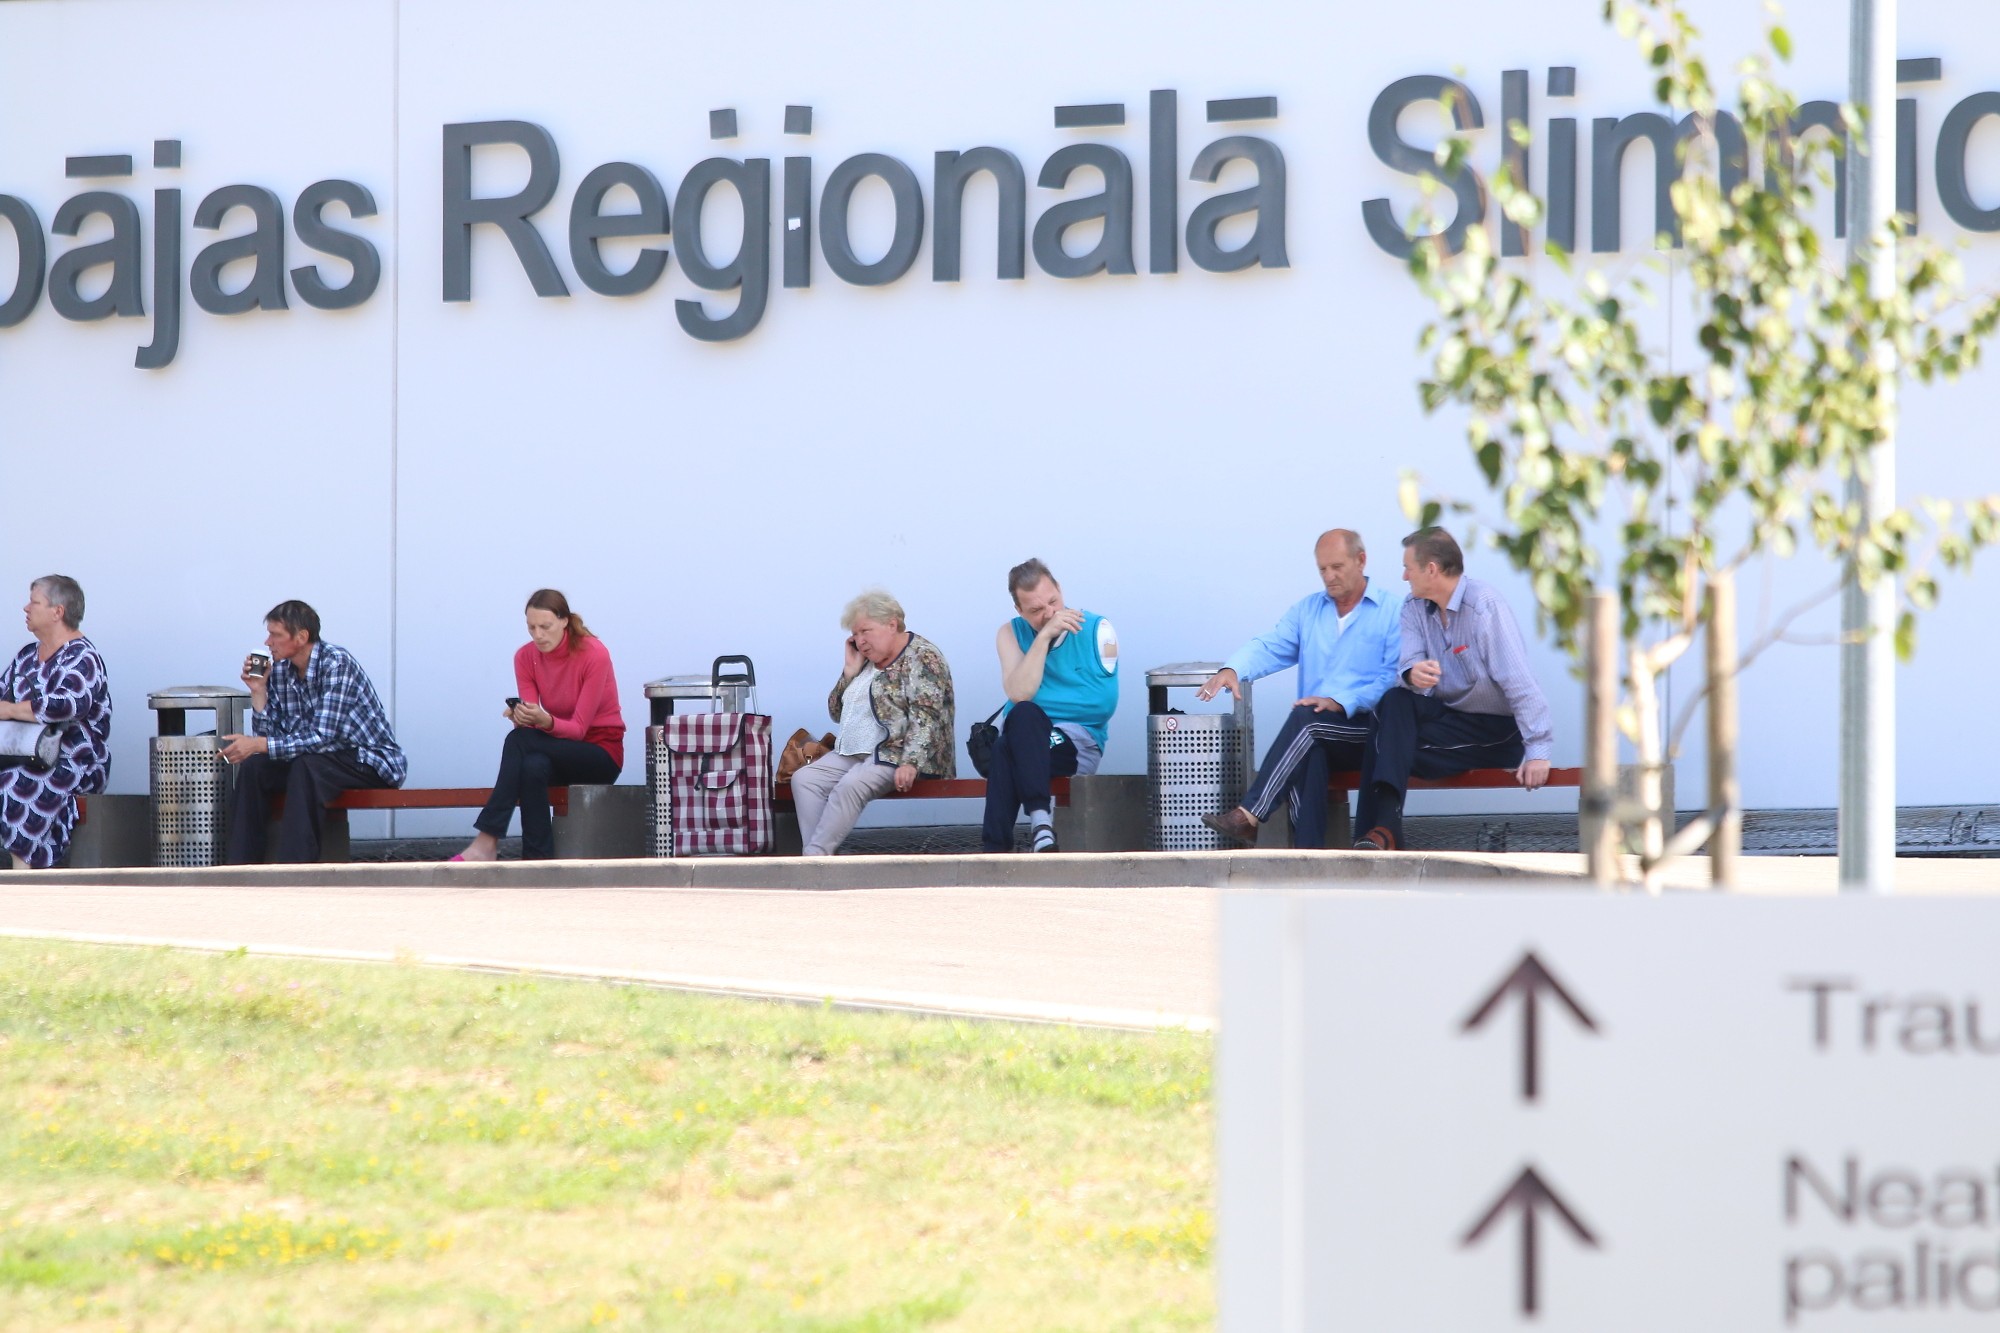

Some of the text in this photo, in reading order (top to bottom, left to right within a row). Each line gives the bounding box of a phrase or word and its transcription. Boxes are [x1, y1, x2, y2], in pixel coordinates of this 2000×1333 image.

[442, 89, 1291, 343] Reģionālā
[1783, 973, 2000, 1054] Trau
[1784, 1150, 2000, 1228] Nea
